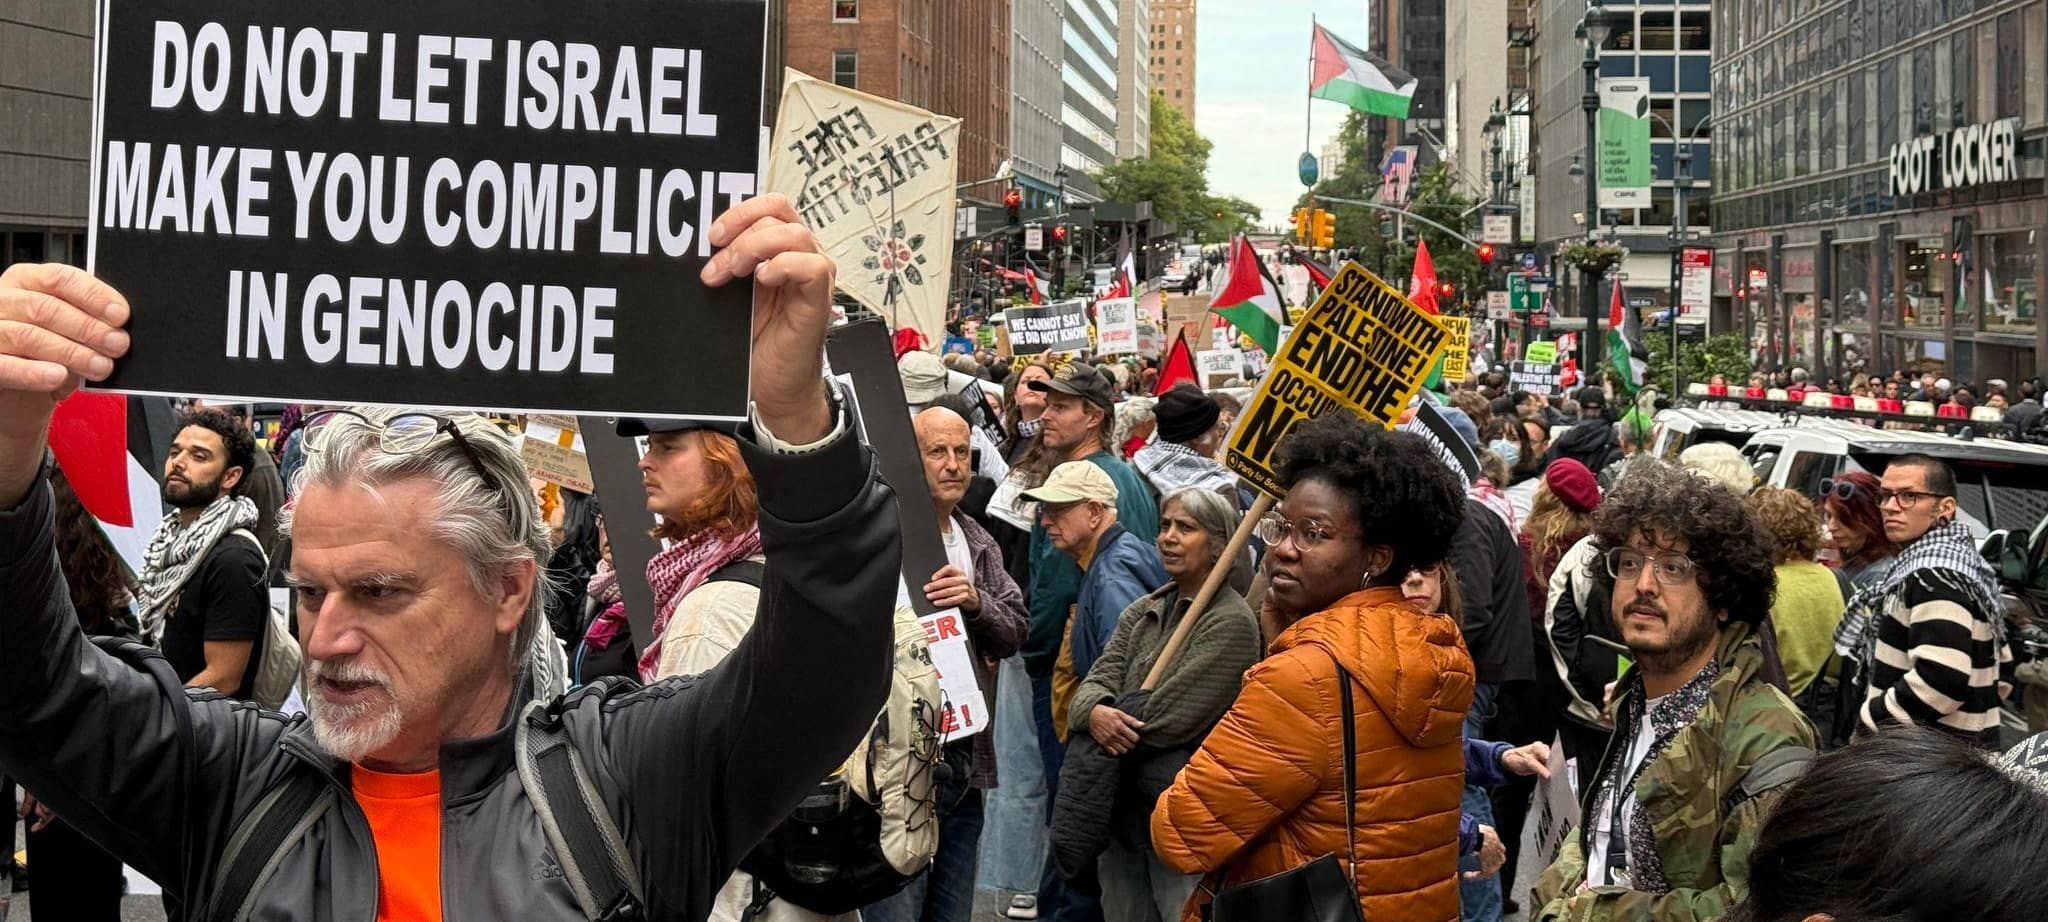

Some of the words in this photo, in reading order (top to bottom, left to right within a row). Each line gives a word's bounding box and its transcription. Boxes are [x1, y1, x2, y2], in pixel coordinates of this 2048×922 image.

[150, 20, 231, 113] DO
[242, 26, 368, 119] NOT
[379, 33, 492, 125] LET
[504, 39, 718, 137] ISRAEL
[103, 141, 272, 237] MAKE
[285, 150, 410, 244] YOU
[1889, 135, 1935, 196] FOOT
[1942, 116, 2019, 188] LOCKER
[225, 270, 288, 360] IN
[302, 274, 618, 375] GENOCIDE
[1009, 331, 1025, 345] WE
[1025, 330, 1040, 344] DID
[1040, 329, 1059, 344] NOT
[1011, 318, 1026, 331] WE
[1026, 315, 1061, 330] CANNOT
[1063, 313, 1080, 327] SAY
[1312, 297, 1427, 385] PALESTINE!
[1448, 336, 1465, 347] AR
[1287, 324, 1366, 391] END
[1347, 357, 1408, 422] THE
[1447, 360, 1463, 372] EAST
[921, 615, 962, 643] ER
